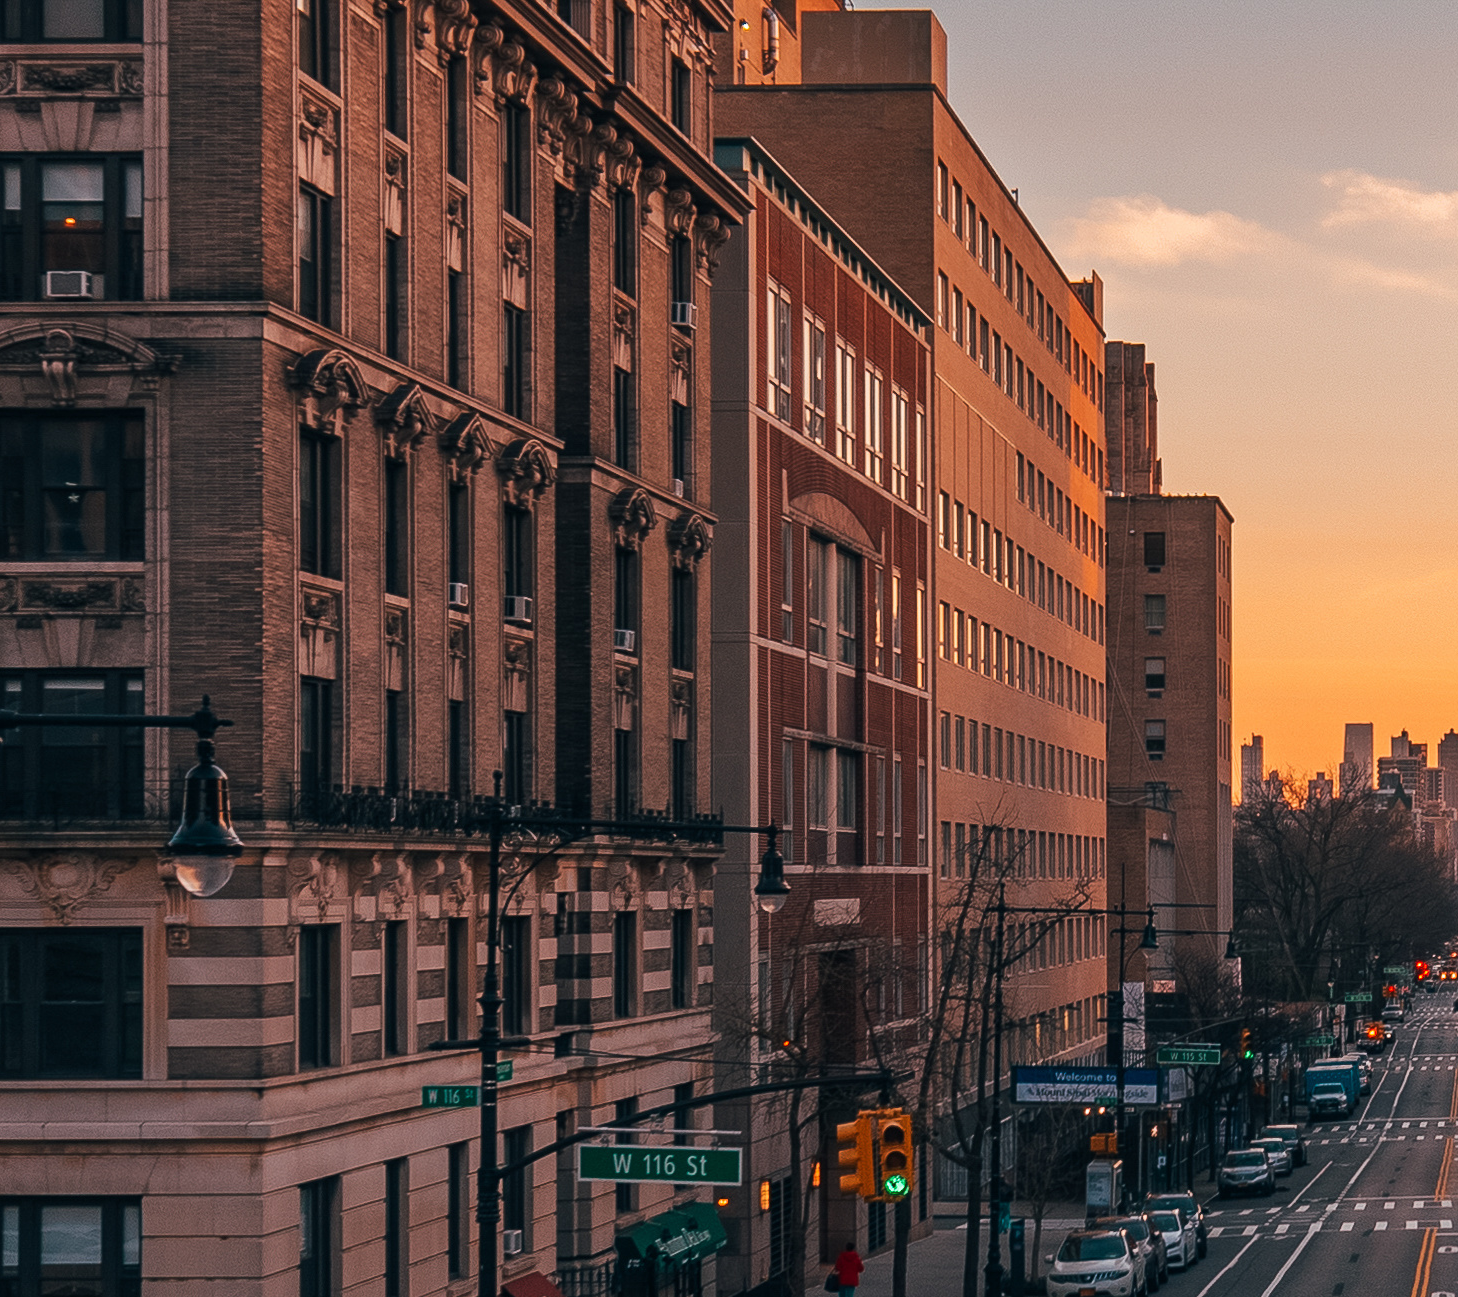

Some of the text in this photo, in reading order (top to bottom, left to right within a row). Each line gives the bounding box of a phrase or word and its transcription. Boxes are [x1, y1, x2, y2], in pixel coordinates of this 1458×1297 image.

[1170, 1052, 1179, 1061] W
[1055, 1072, 1117, 1082] Welcome to
[427, 1088, 474, 1104] W 116 St
[613, 1153, 708, 1177] W 116 St
